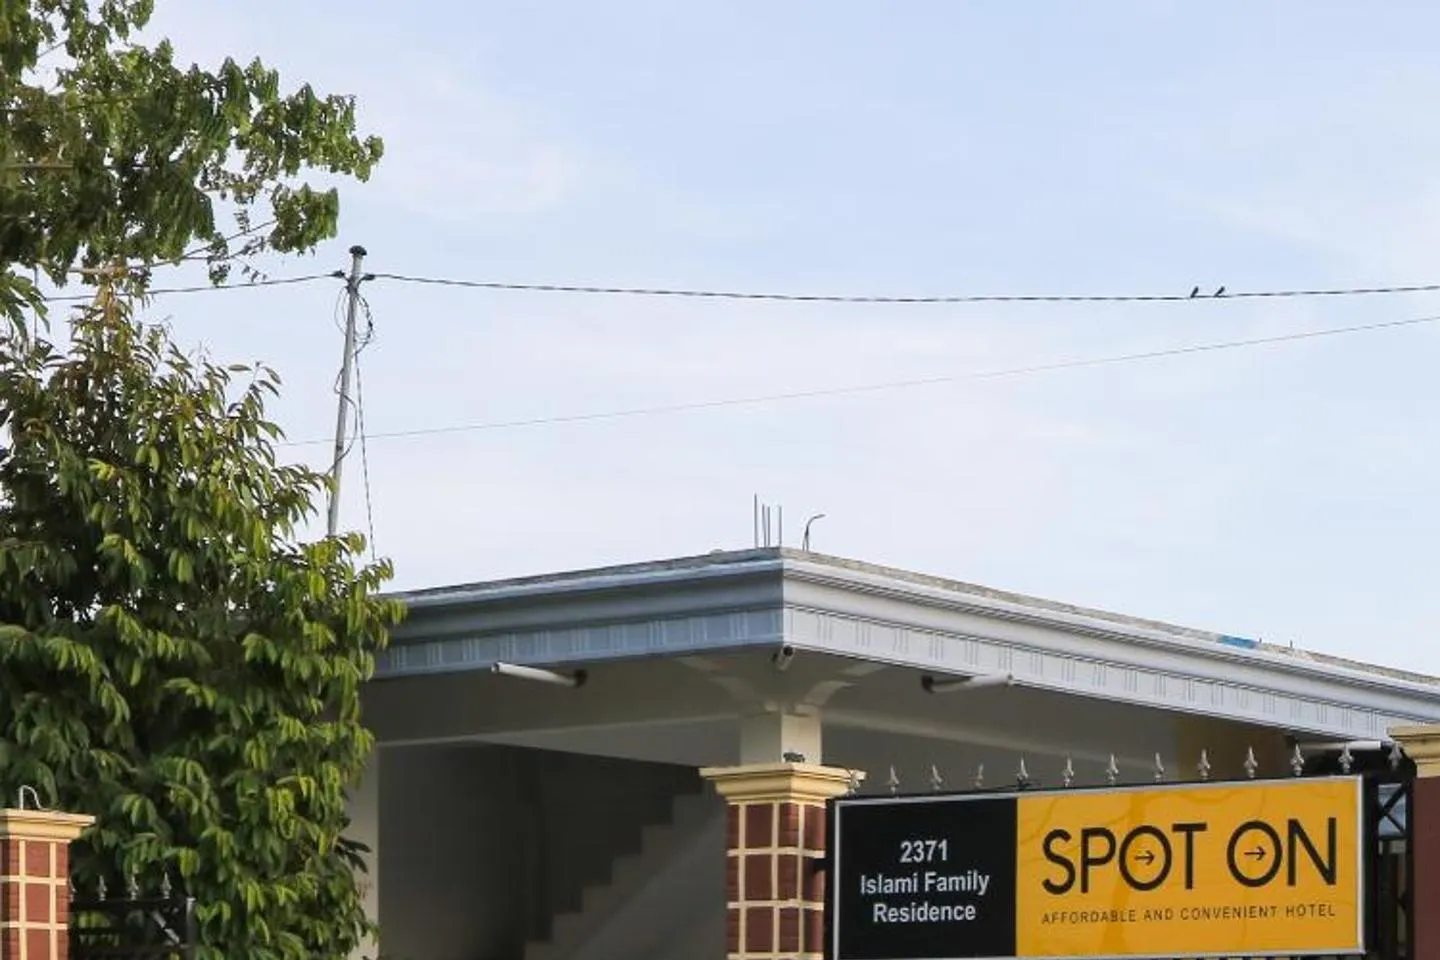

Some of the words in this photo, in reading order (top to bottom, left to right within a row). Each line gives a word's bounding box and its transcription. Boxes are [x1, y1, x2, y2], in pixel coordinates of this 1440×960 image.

[899, 838, 950, 864] 2371
[1041, 821, 1208, 895] SPOT
[1226, 816, 1337, 888] ON
[860, 872, 919, 896] Islami
[923, 870, 990, 897] Family
[872, 901, 977, 924] Residence
[1041, 906, 1137, 925] AFFORDABLE
[1143, 906, 1174, 922] AND
[1179, 904, 1278, 922] CONVENIENT
[1284, 902, 1337, 919] HOTEL
